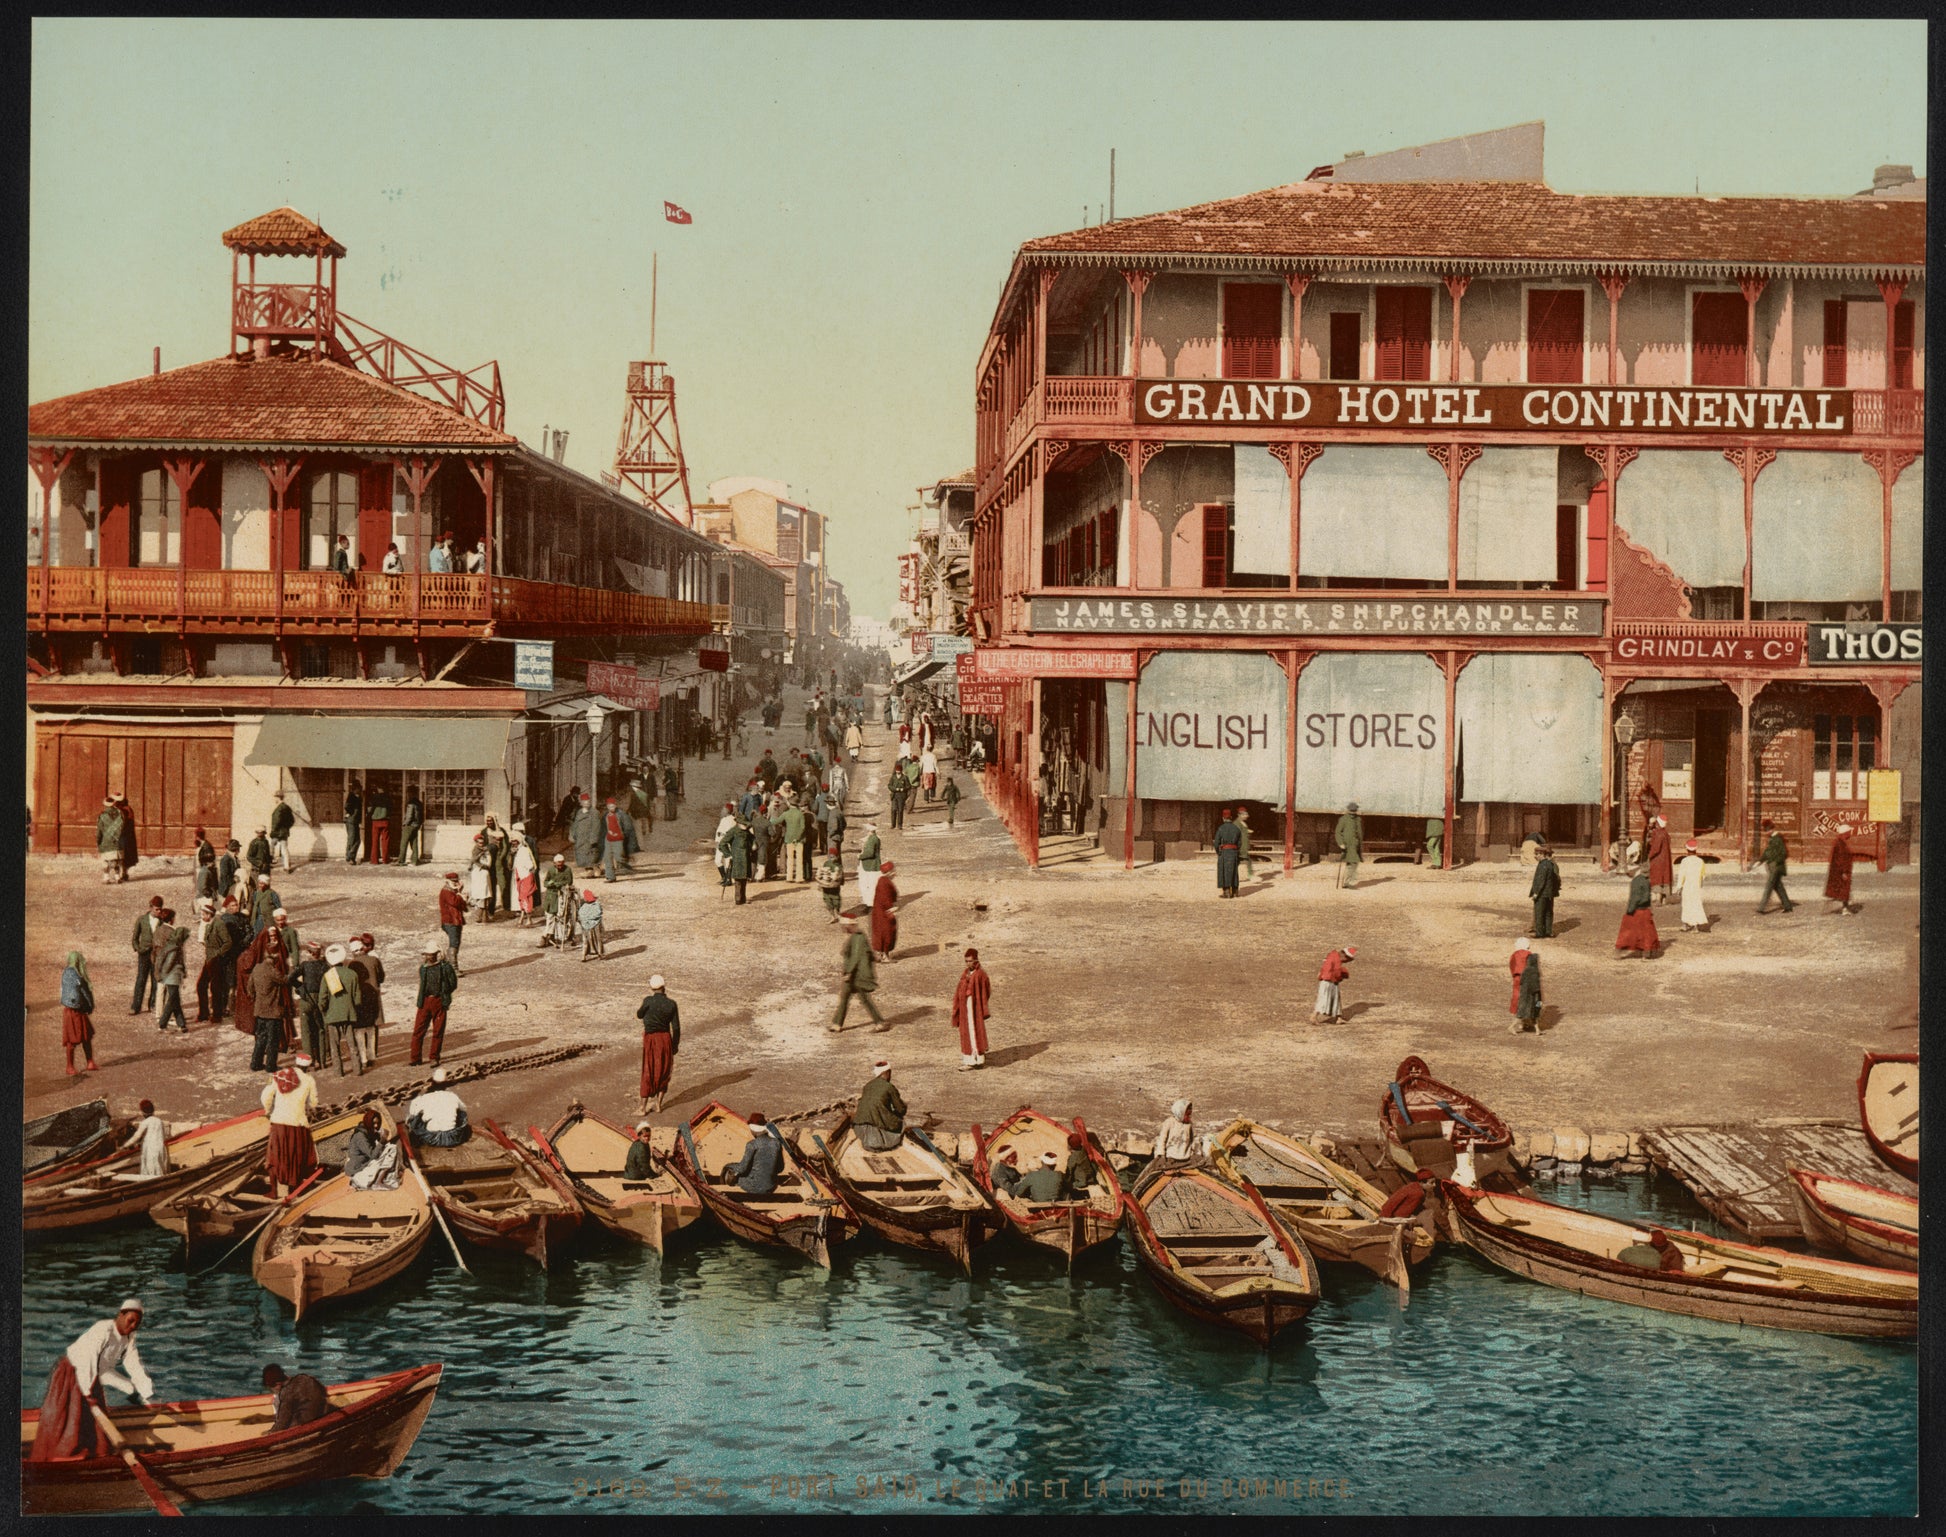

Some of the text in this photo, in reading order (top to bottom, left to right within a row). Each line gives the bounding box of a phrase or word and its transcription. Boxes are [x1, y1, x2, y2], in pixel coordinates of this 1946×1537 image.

[1145, 384, 1845, 430] GRAND HOTEL CONTINENTAL
[1055, 601, 1579, 621] JAMES SLAVICK SHIPCHANDLER
[1056, 618, 1115, 628] NAVY
[1328, 621, 1340, 630] &
[1383, 620, 1501, 632] PURVEYOR
[1618, 638, 1739, 658] GRINDLAY
[1744, 650, 1754, 660] &
[1821, 628, 1922, 659] THOS
[978, 652, 1134, 669] TO THE EASTERN TELEGRAPH OFFICE
[962, 693, 1003, 703] CIGARETTES
[961, 704, 1004, 714] MANUFACTORY
[1305, 713, 1437, 749] STORES
[1838, 811, 1861, 822] COOK
